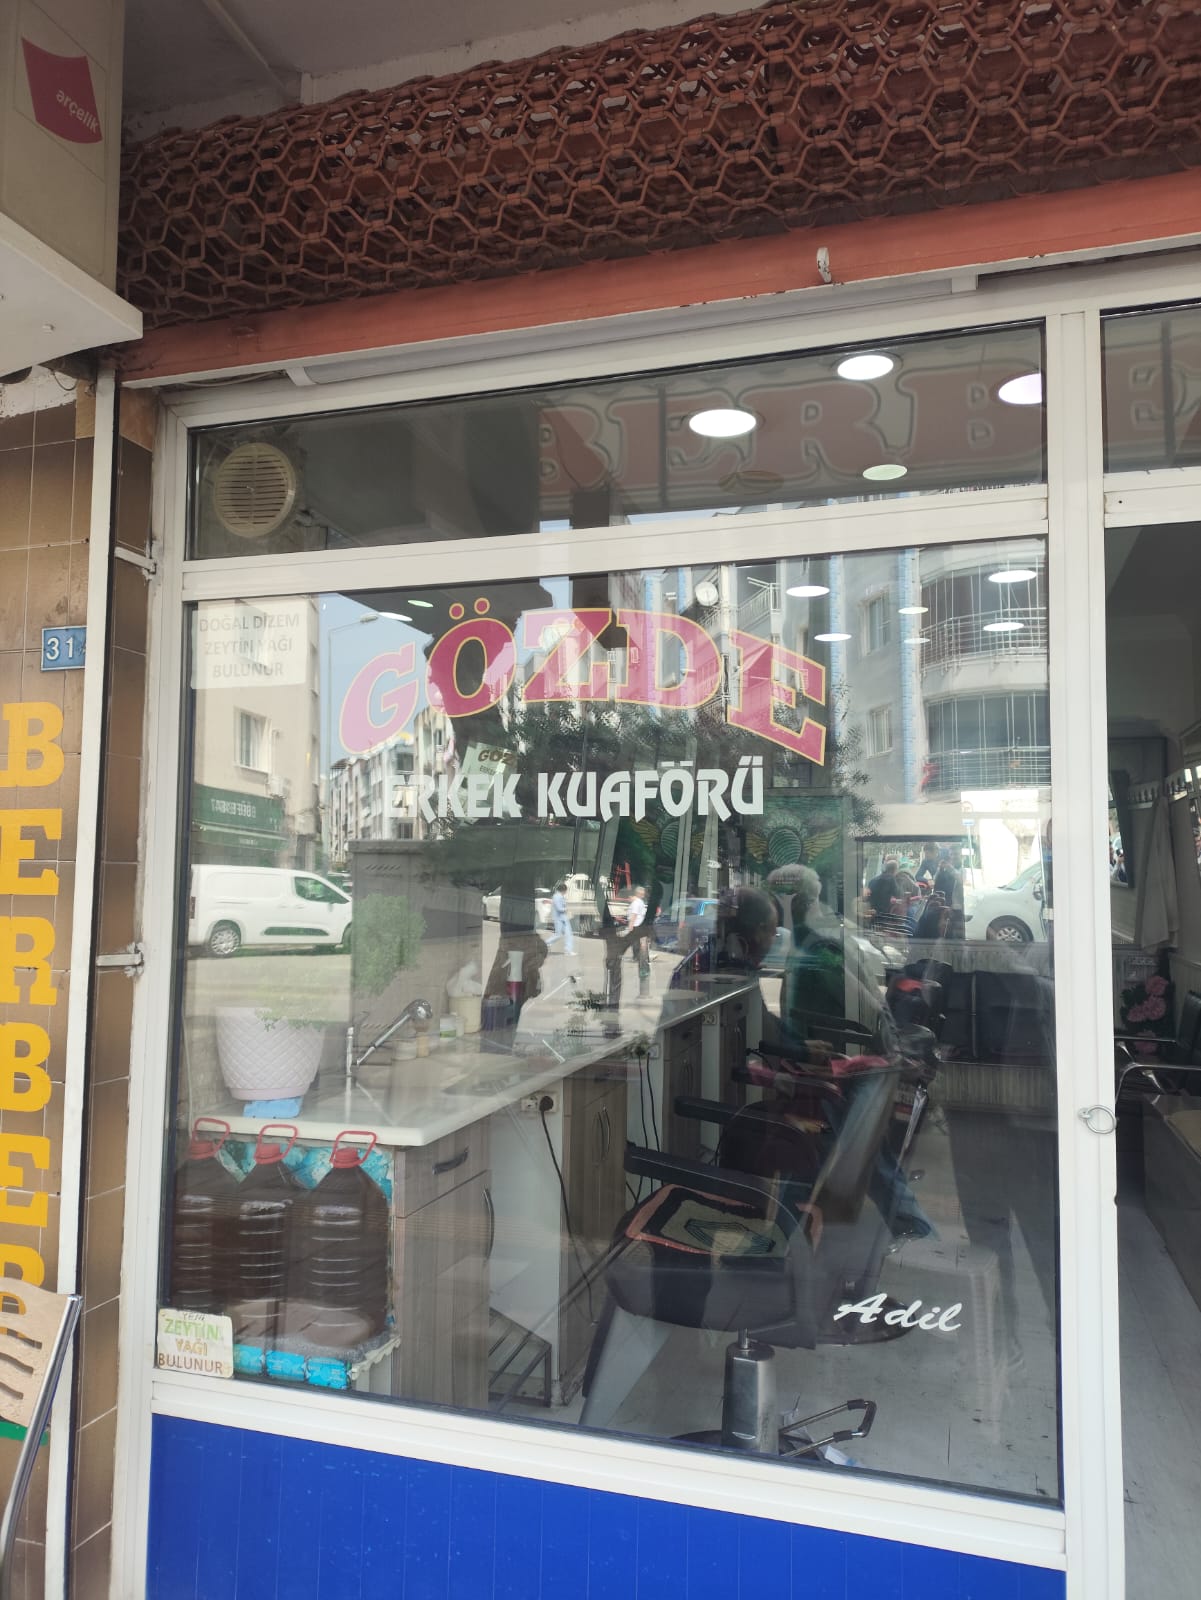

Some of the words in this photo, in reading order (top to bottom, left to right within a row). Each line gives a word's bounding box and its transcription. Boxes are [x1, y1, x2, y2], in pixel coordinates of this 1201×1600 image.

[56, 89, 99, 133] arçelik
[200, 614, 249, 632] DOĞAL
[253, 613, 299, 629] DİZEM
[205, 637, 254, 655] ZEYTİN
[258, 635, 293, 652] YAĞI
[213, 662, 284, 678] BULUNUR
[339, 597, 826, 766] GÖZDE
[386, 773, 523, 823] ERKEK
[537, 755, 764, 822] KUAFÖRÜ
[833, 1293, 962, 1331] Adil
[158, 1353, 223, 1374] BULUNUR
